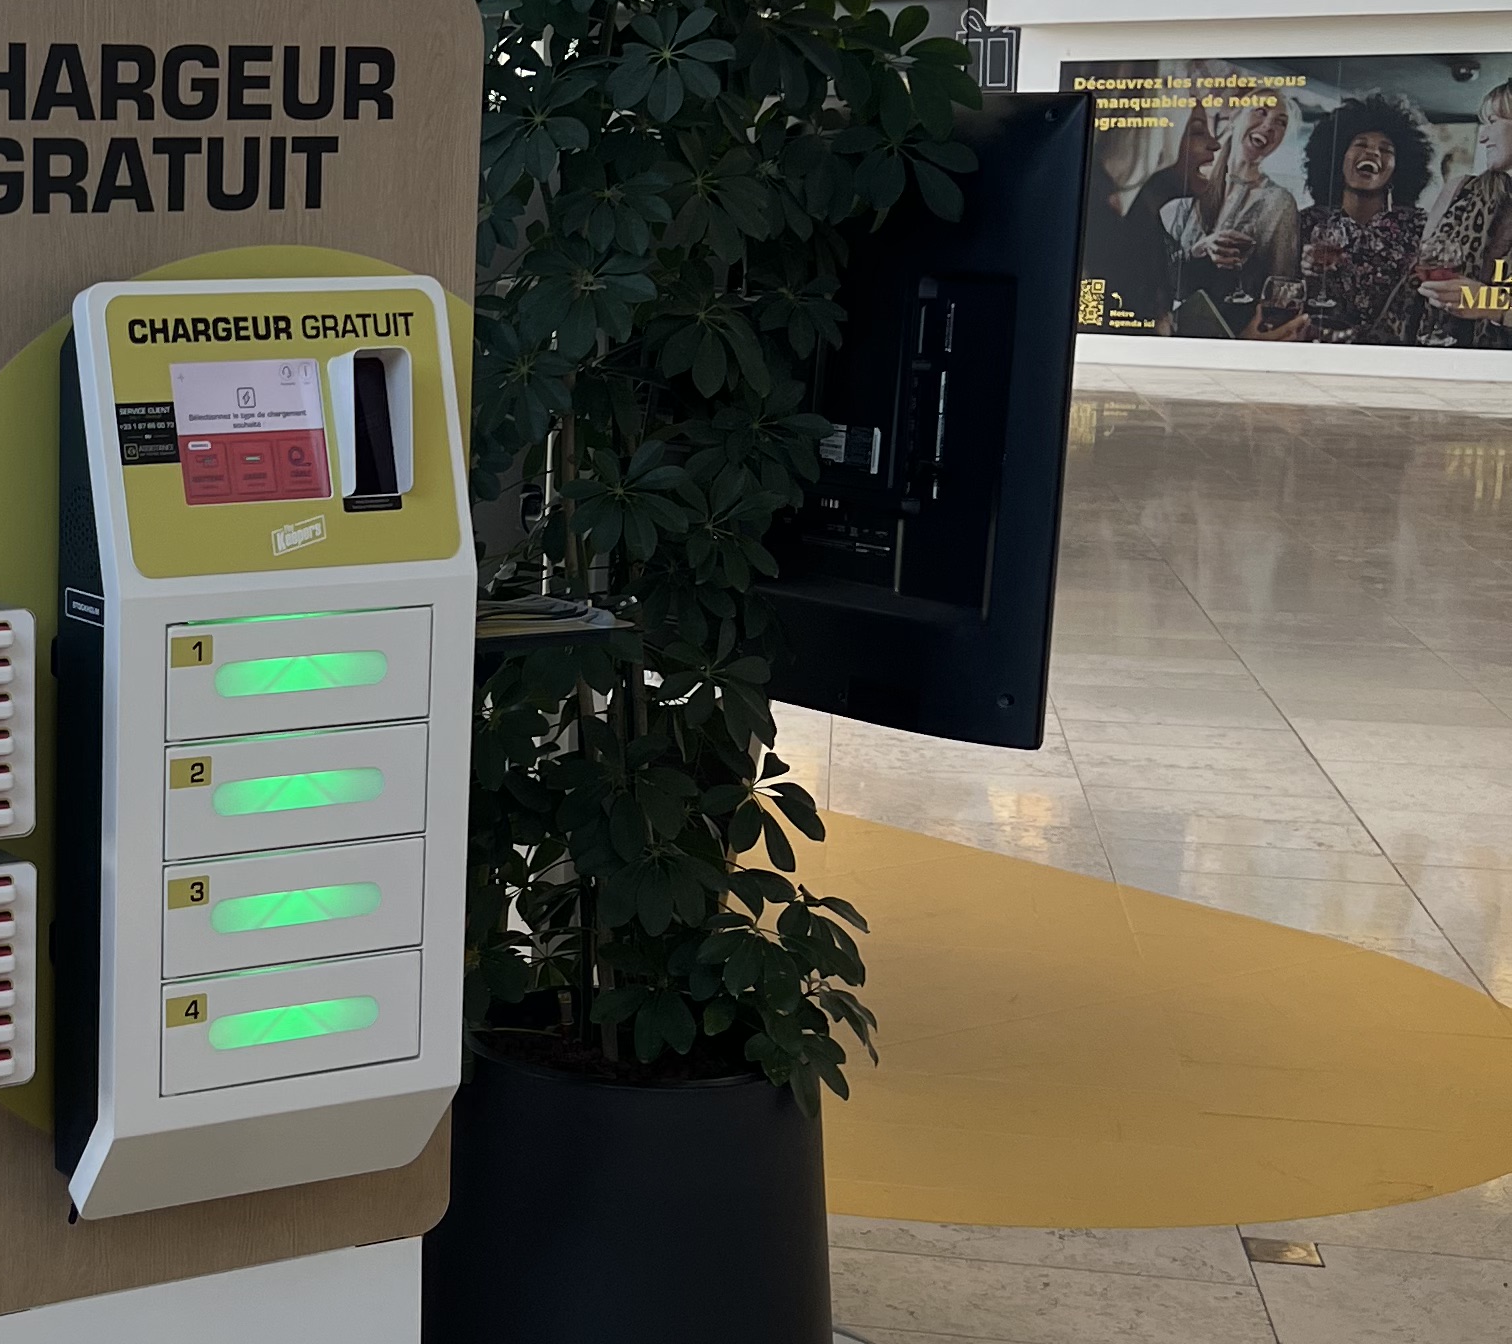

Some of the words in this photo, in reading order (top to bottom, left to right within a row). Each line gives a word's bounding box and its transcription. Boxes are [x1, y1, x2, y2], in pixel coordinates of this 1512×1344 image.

[1073, 75, 1163, 90] Découvrez
[1167, 75, 1192, 89] les
[1195, 74, 1307, 89] rendez-vous
[1095, 94, 1197, 112] manquables
[1201, 94, 1224, 108] de
[1228, 95, 1278, 108] notre
[1094, 115, 1175, 131] gramme.
[1458, 285, 1512, 310] ME
[127, 314, 293, 345] CHARGEUR
[301, 311, 414, 339] GRATUIT
[119, 407, 146, 415] SERVICE
[147, 406, 171, 414] CLIENT
[267, 410, 307, 419] chargement
[276, 522, 322, 552] Keepers
[192, 640, 203, 662] 1
[190, 762, 205, 783] 2
[190, 881, 204, 903] 3
[184, 999, 200, 1020] 4
